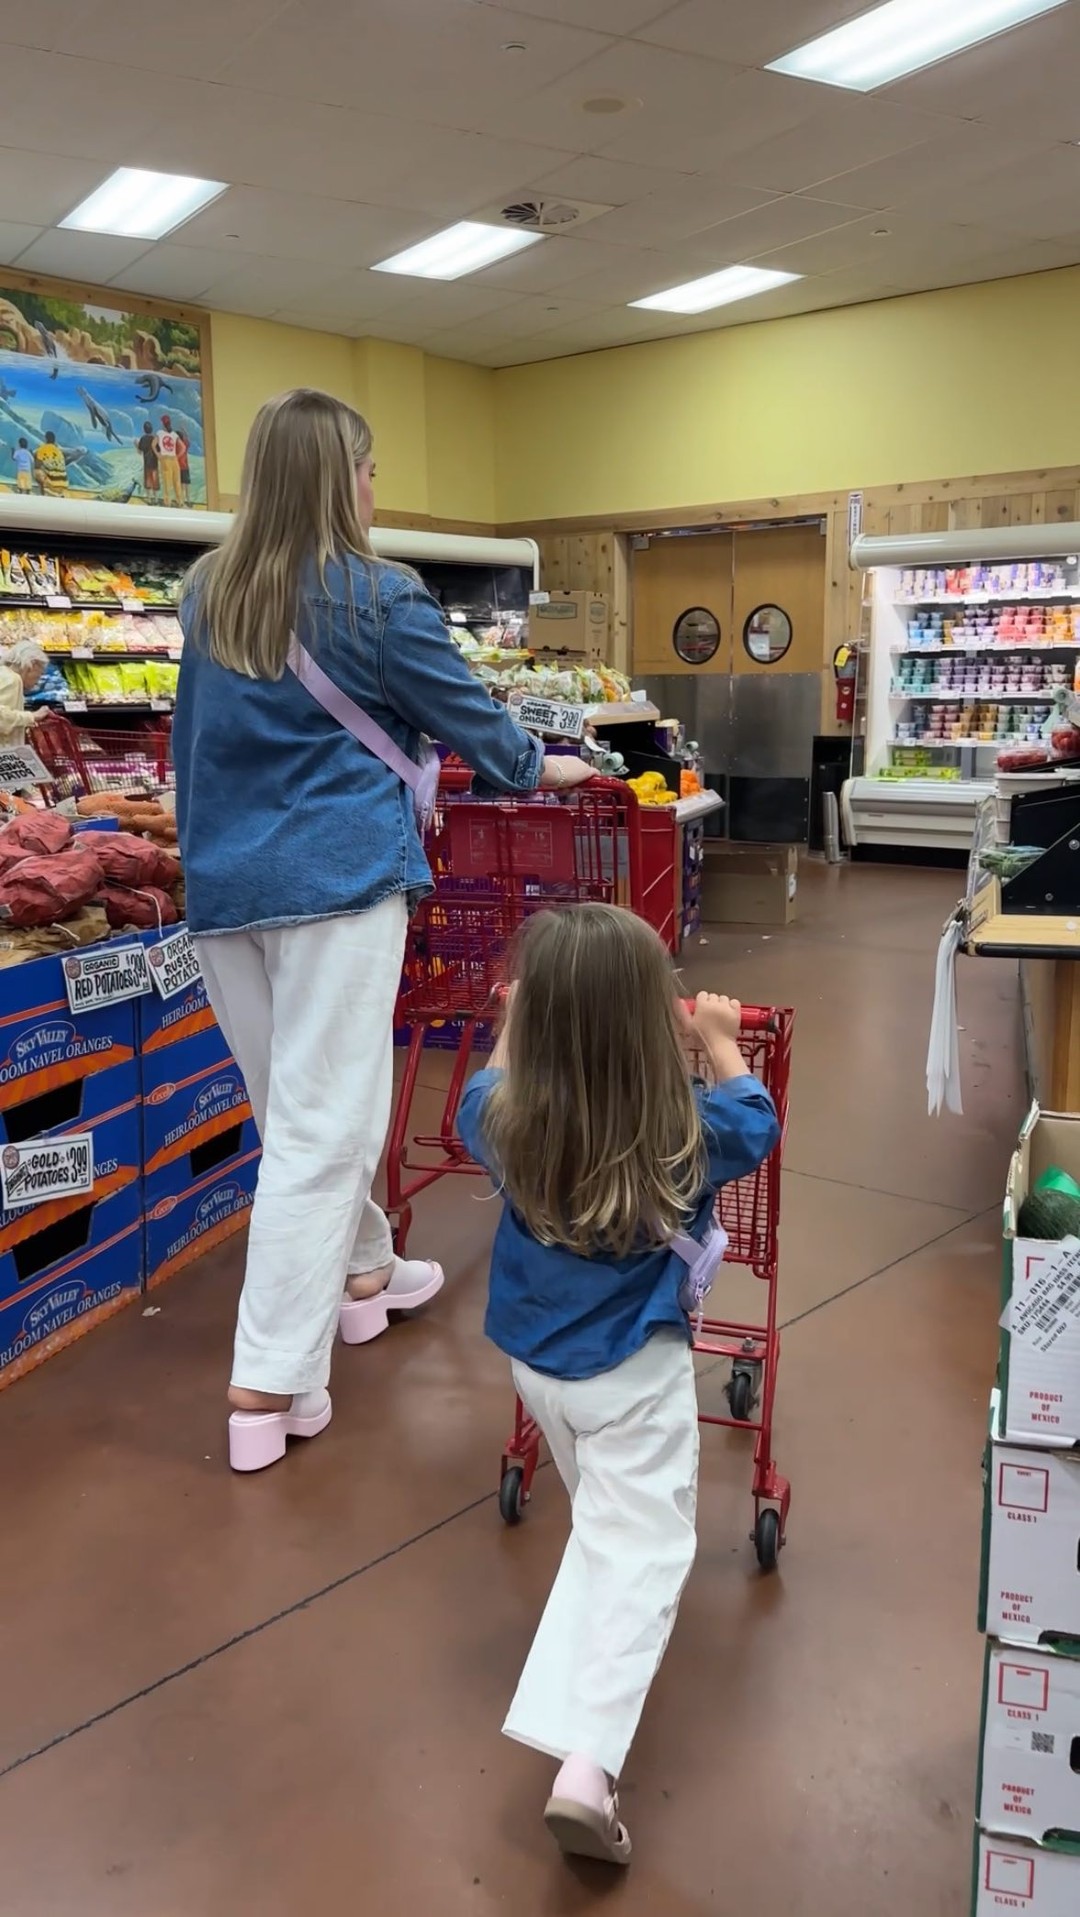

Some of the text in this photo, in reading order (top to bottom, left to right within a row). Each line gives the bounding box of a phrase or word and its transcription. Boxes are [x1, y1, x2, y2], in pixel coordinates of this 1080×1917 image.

[520, 705, 558, 720] SWEET
[519, 715, 555, 727] ONIONS
[84, 957, 118, 972] ORGANIC
[165, 946, 197, 976] RUSSE
[75, 977, 94, 1001] RED
[94, 968, 133, 996] POTATOES
[162, 998, 206, 1028] HEIRLOOM
[30, 1047, 64, 1070] NAVEL
[66, 1035, 113, 1057] ORANGES
[164, 1109, 207, 1146] HEIRLOOM
[205, 1099, 231, 1118] NAVEL
[32, 1151, 59, 1169] GOLD
[24, 1167, 69, 1193] POTATOES
[167, 1219, 209, 1259] HEIRLOOM
[209, 1203, 233, 1227] NAVEL
[1019, 1295, 1043, 1322] AVOCADO
[1041, 1282, 1055, 1296] BAG
[1052, 1267, 1068, 1284] HASS
[43, 1308, 76, 1337] NAVEL
[77, 1281, 122, 1313] ORANGES
[1029, 1390, 1063, 1403] PRODUCT
[1041, 1403, 1050, 1411] OF
[1031, 1412, 1060, 1424] MEXICO
[1007, 1511, 1033, 1523] CLASS
[1000, 1591, 1033, 1603] PRODUCT
[1012, 1603, 1021, 1611] OF
[1002, 1612, 1031, 1623] MEXICO
[1007, 1709, 1032, 1721] CLASS
[1001, 1783, 1035, 1796] PRODUCT
[1012, 1795, 1022, 1803] OF
[1003, 1803, 1032, 1815] MEXICO
[994, 1895, 1018, 1907] CLASS
